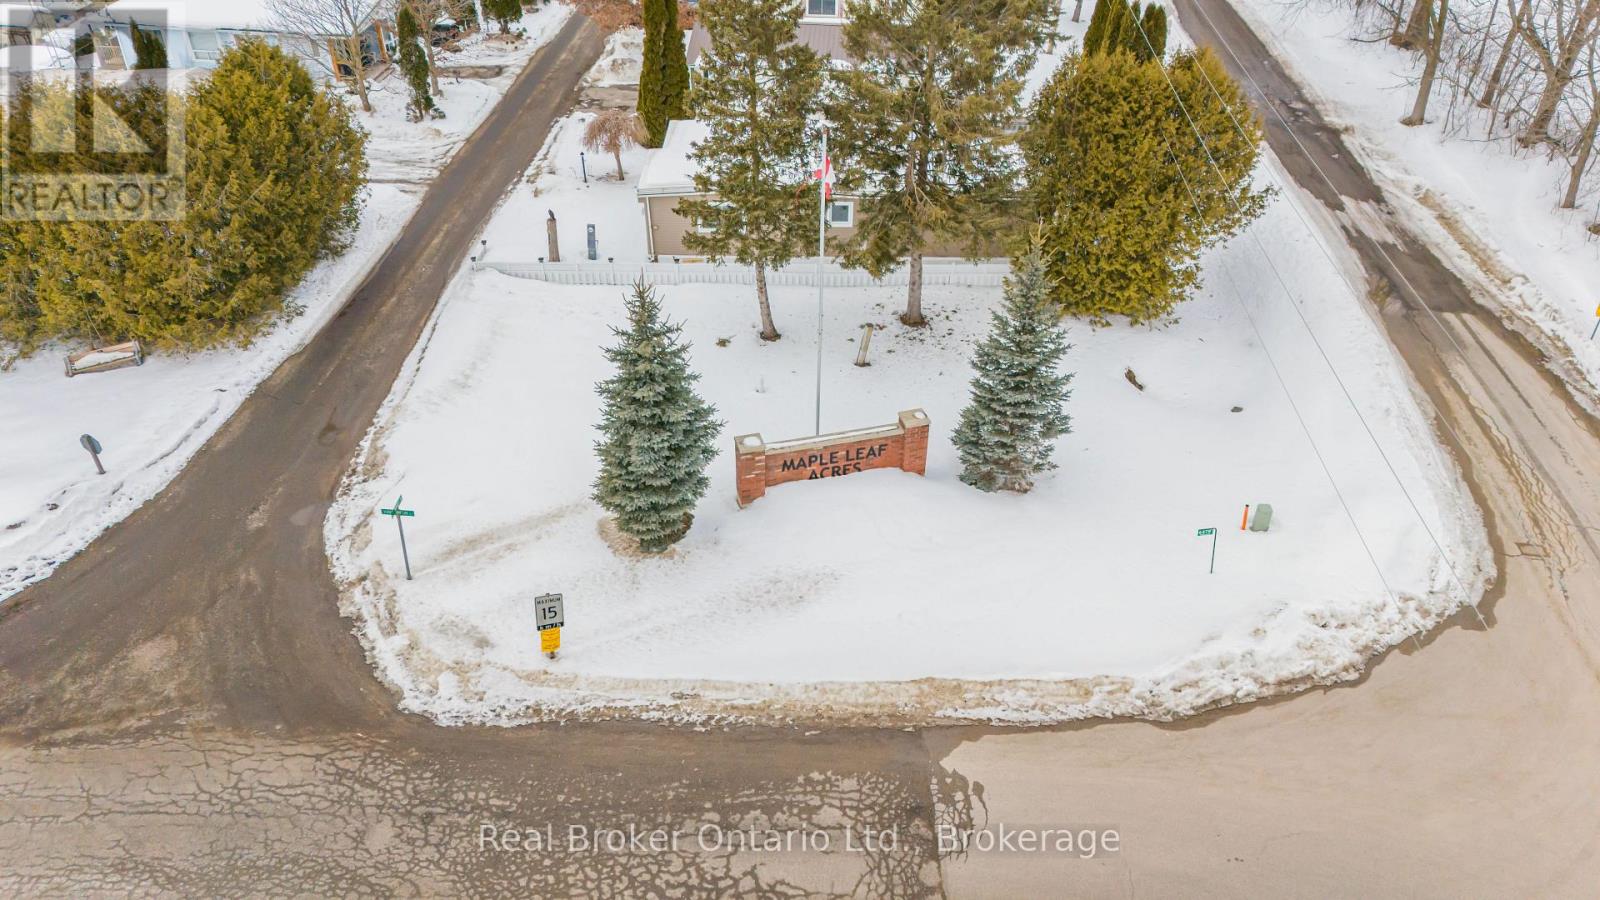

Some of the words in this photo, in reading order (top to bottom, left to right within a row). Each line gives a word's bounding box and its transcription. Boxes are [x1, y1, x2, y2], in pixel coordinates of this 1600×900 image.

[782, 451, 840, 472] MAPLE
[846, 443, 888, 462] LEAF
[808, 462, 863, 480] ACRES
[536, 597, 561, 605] MAXIMUM
[542, 605, 557, 620] 15
